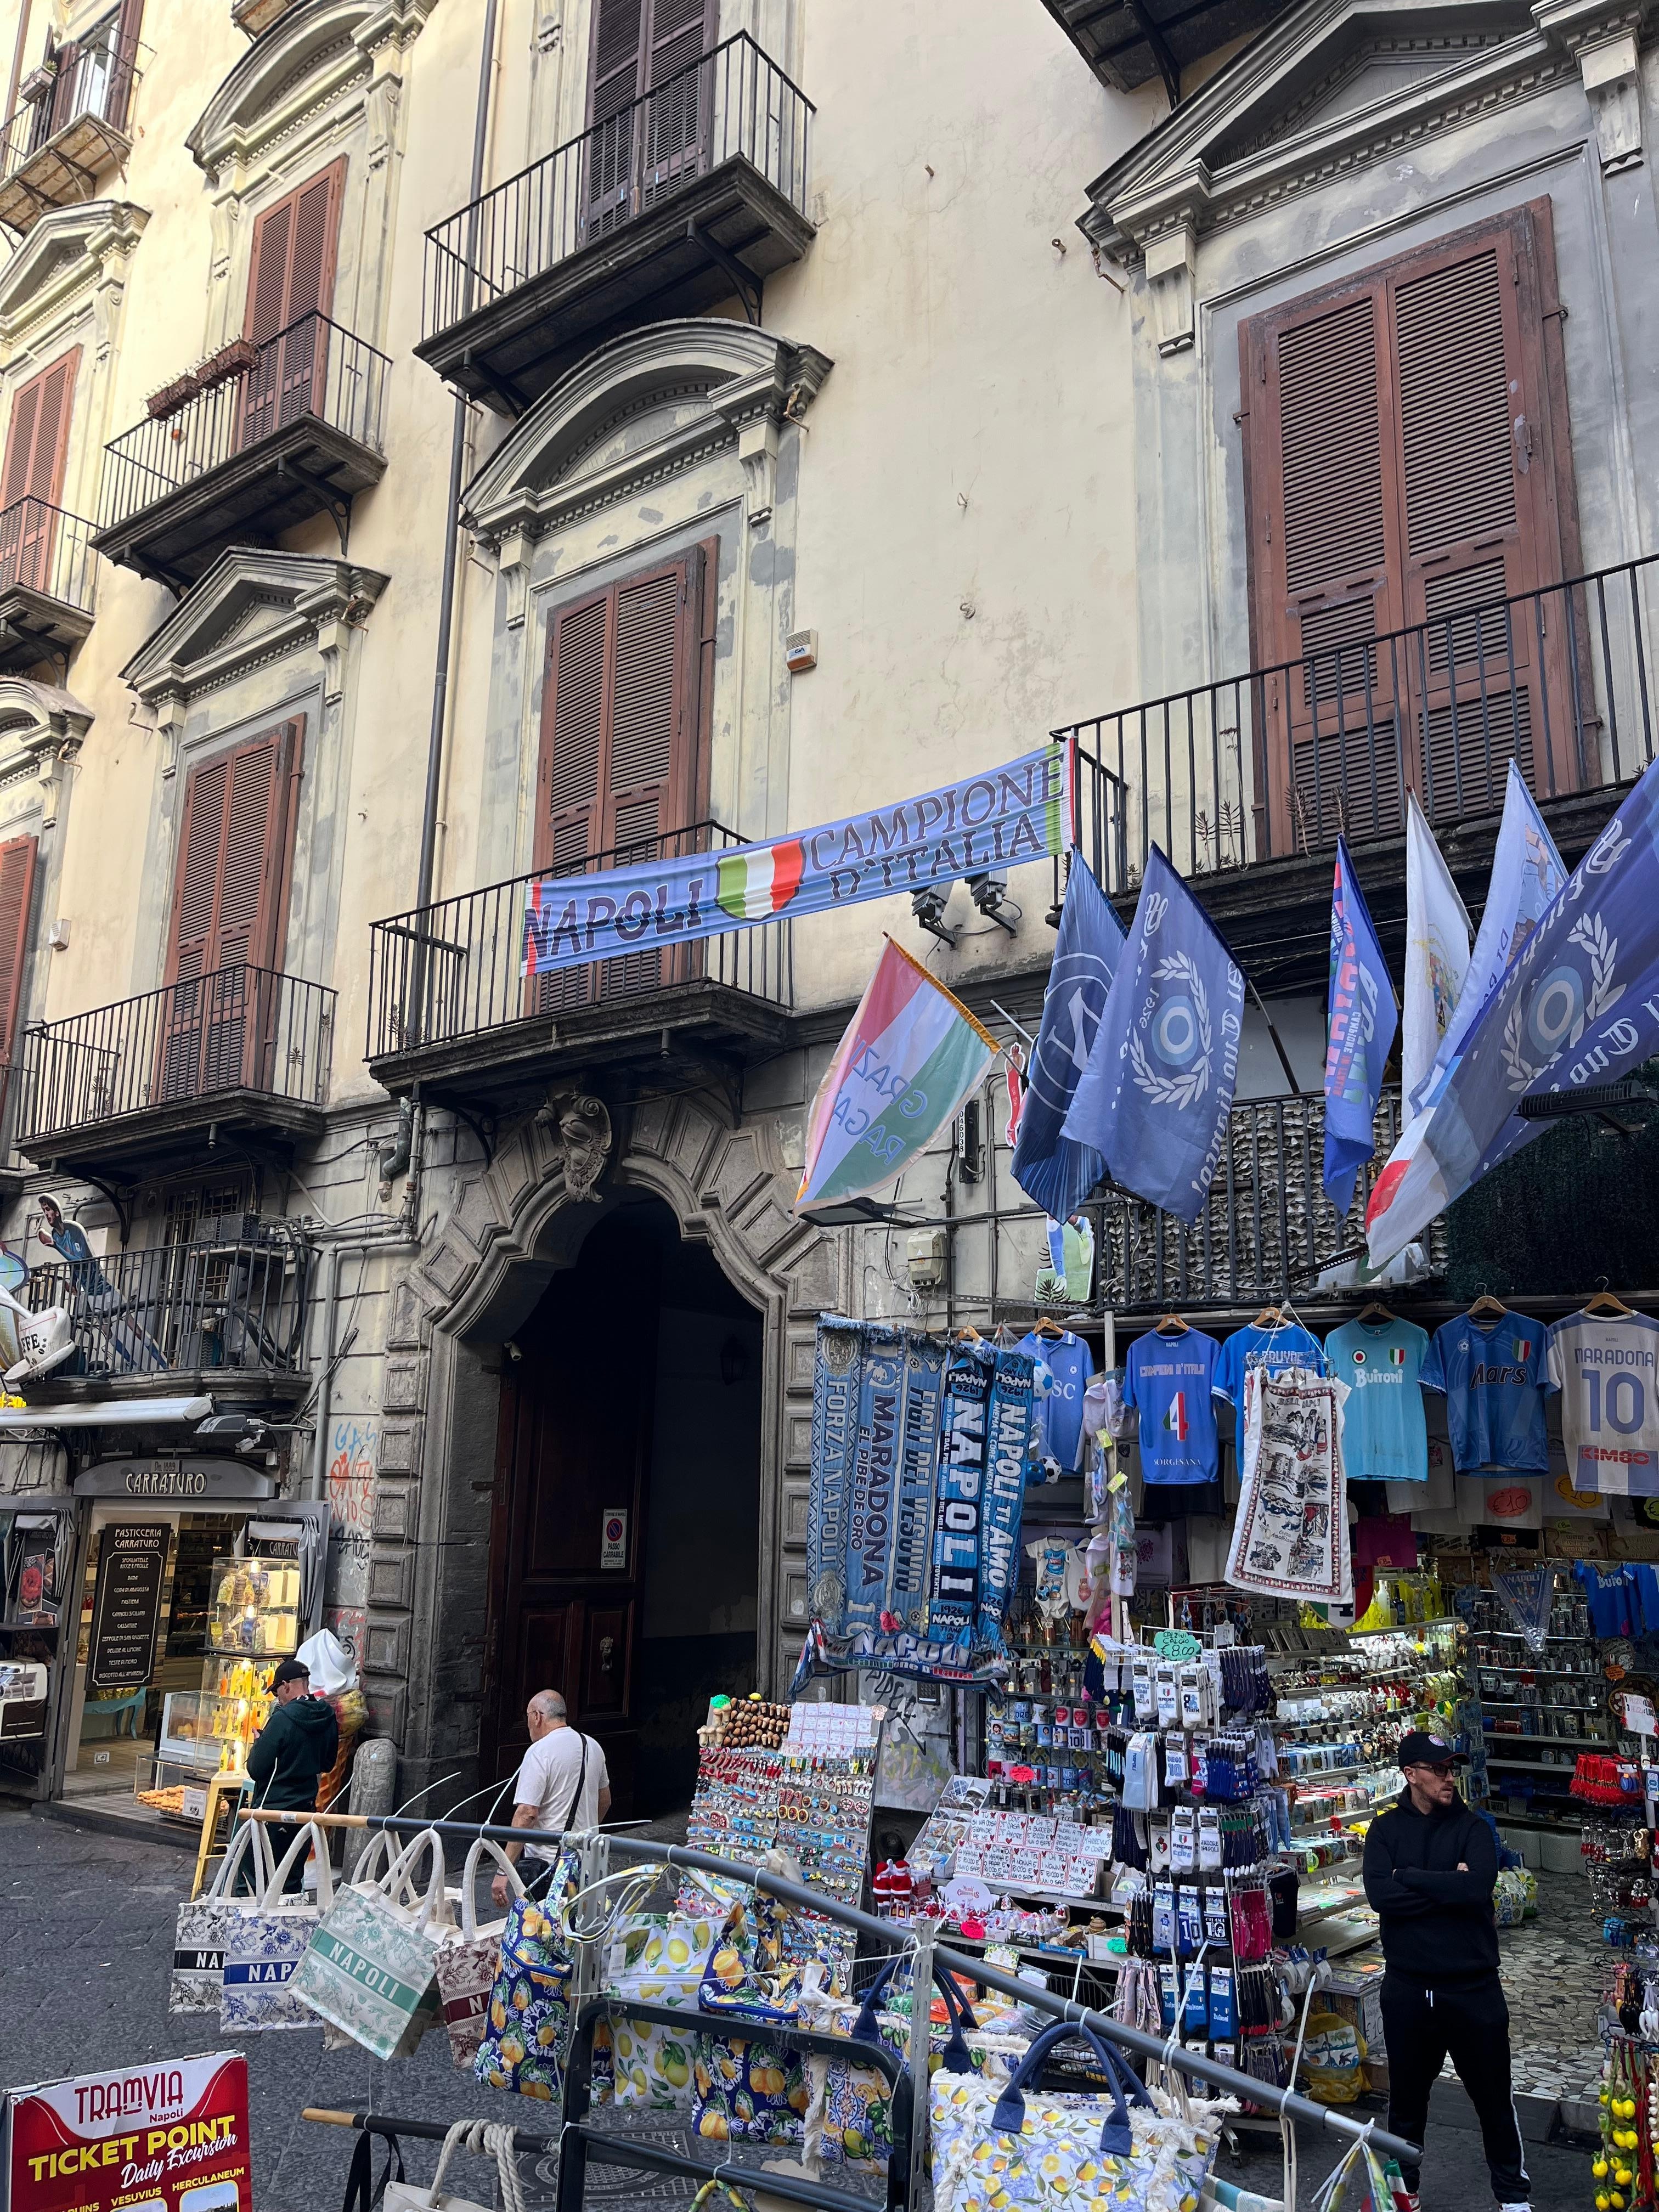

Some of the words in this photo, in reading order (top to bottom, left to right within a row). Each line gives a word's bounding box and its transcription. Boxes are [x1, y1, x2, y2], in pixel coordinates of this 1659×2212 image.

[809, 753, 1064, 871] CAMPIONE
[830, 814, 1045, 901] D'ITALIA
[522, 879, 703, 962] NAPOLI
[1470, 1361, 1527, 1390] Mars
[1575, 1347, 1654, 1367] MARADONA
[995, 1372, 1031, 1388] NAPOLI
[1355, 1368, 1404, 1387] Buitoni
[1162, 1391, 1189, 1441] 4
[1582, 1369, 1644, 1435] 10
[824, 1380, 848, 1463] FORZA
[857, 1424, 871, 1444] EL
[855, 1447, 870, 1486] PIBE
[903, 1447, 932, 1487] DEL
[993, 1402, 1027, 1501] NAPOLI
[1582, 1447, 1650, 1465] KIMBO
[126, 1473, 207, 1494] CARRATURO
[853, 1488, 866, 1511] DE
[861, 1394, 896, 1587] MARADONA
[941, 1399, 984, 1592] NAPOLI
[821, 1469, 843, 1564] NAPOLI
[850, 1513, 865, 1550] ORO
[995, 1505, 1011, 1523] TI
[115, 1529, 162, 1537] PASTICCERIA
[115, 1539, 159, 1548] CARRATURO
[988, 1525, 1014, 1588] AMO
[1506, 1575, 1540, 1583] NAPOLI
[933, 1614, 970, 1626] NAPOLI
[940, 1605, 963, 1615] 1926
[852, 1630, 971, 1668] NAPOLI
[1168, 1763, 1182, 1777] 10
[328, 1943, 400, 2001] NAPOLI
[75, 2070, 184, 2124] TRAMVIA
[149, 2108, 184, 2124] Napoli
[28, 2138, 140, 2182] TICKET
[148, 2114, 236, 2156] POINT
[121, 2159, 165, 2190] Daily
[167, 2133, 238, 2171] Excursion
[111, 2187, 162, 2207] VESUVIUS
[172, 2167, 245, 2192] HERCULANEUM
